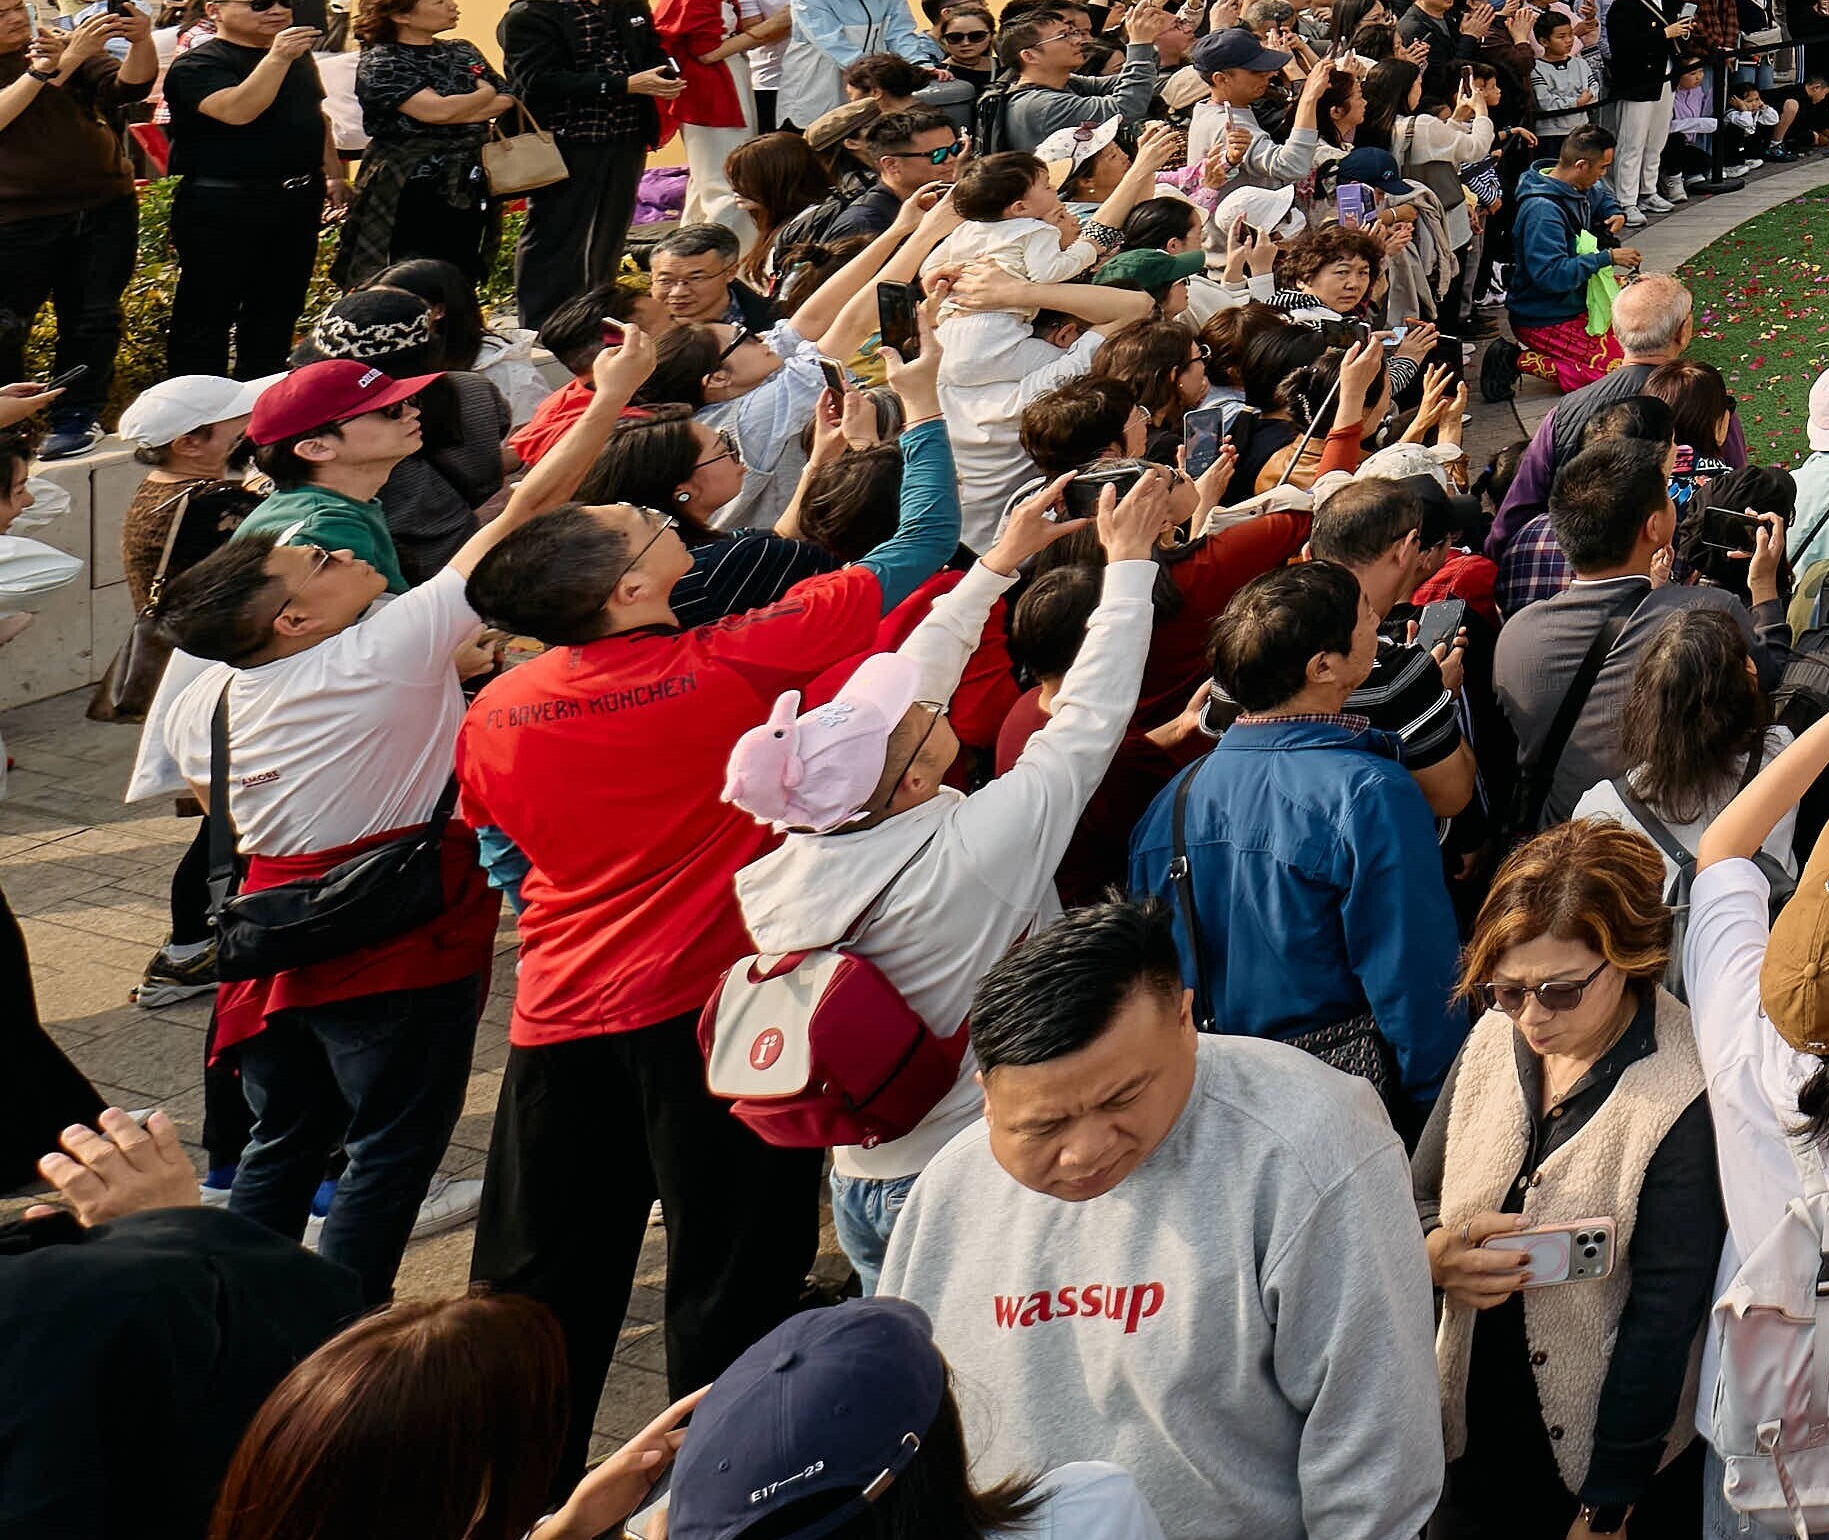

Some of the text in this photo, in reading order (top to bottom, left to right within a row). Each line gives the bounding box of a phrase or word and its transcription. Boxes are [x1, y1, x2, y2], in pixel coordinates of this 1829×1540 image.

[486, 709, 503, 731] FC
[509, 699, 582, 727] BAYERN
[993, 1279, 1166, 1335] wassup
